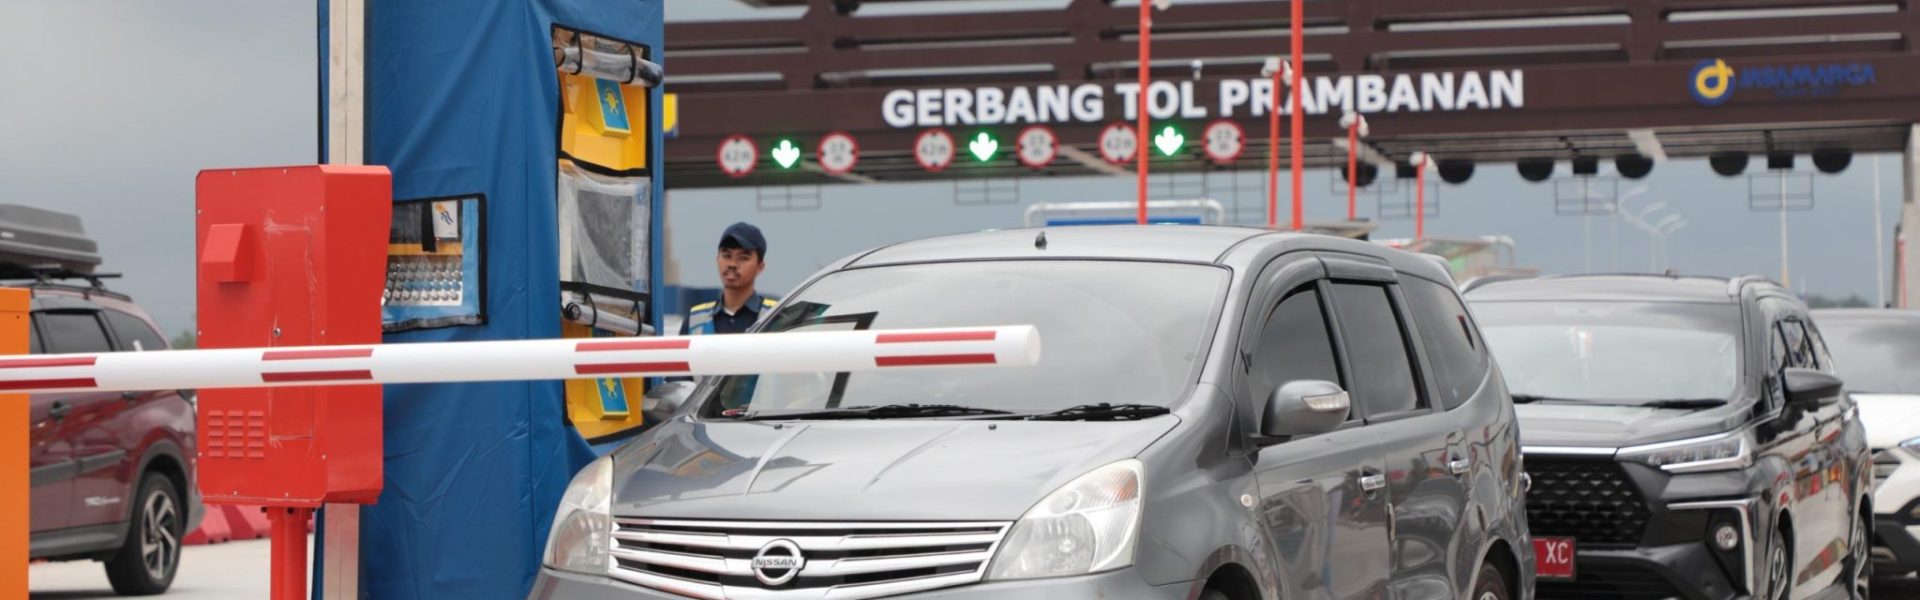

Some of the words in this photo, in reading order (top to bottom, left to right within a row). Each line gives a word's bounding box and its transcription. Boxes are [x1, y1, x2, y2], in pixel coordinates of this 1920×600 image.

[882, 84, 1104, 127] GERBANG
[1114, 81, 1207, 120] TOL
[755, 558, 797, 567] NISSAN
[1546, 541, 1569, 564] XC
